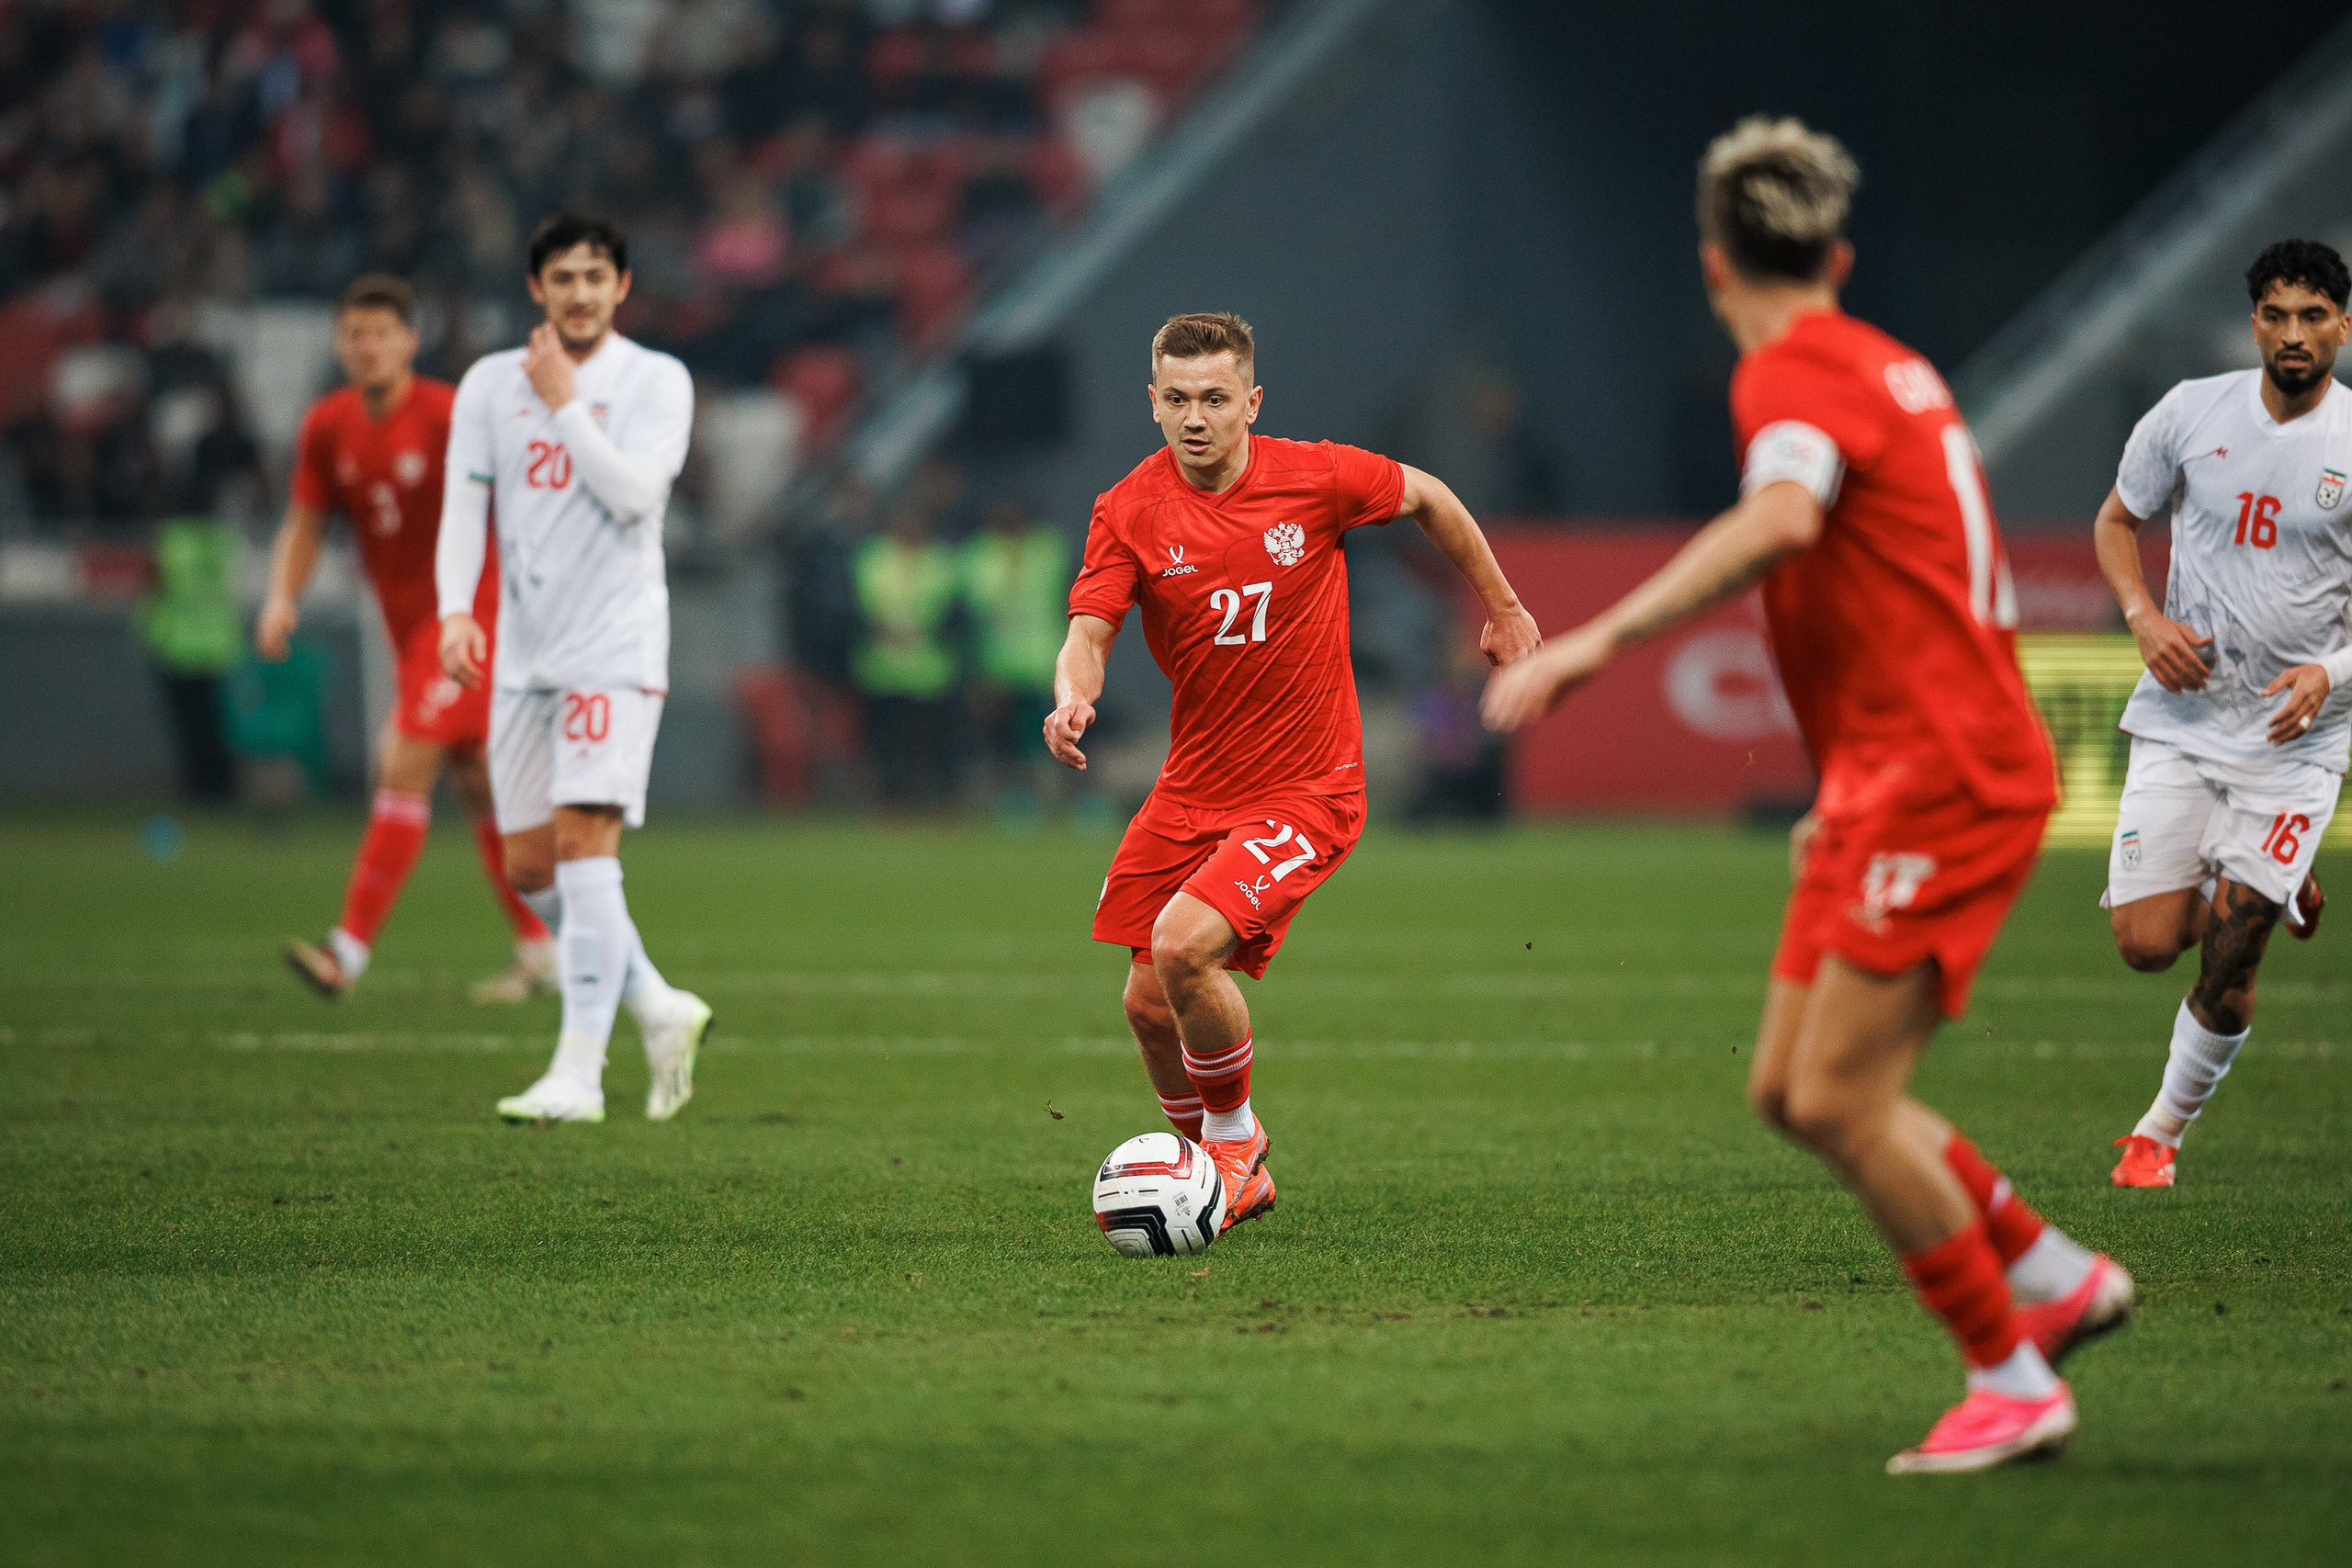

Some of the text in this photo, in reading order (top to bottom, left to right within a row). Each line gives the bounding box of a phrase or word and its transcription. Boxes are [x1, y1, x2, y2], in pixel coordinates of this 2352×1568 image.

[526, 440, 572, 491] 20
[2233, 491, 2283, 550] 16
[1209, 581, 1273, 646] 27
[565, 692, 611, 742] 20
[1241, 818, 1317, 883] 27
[2259, 810, 2311, 865] 16
